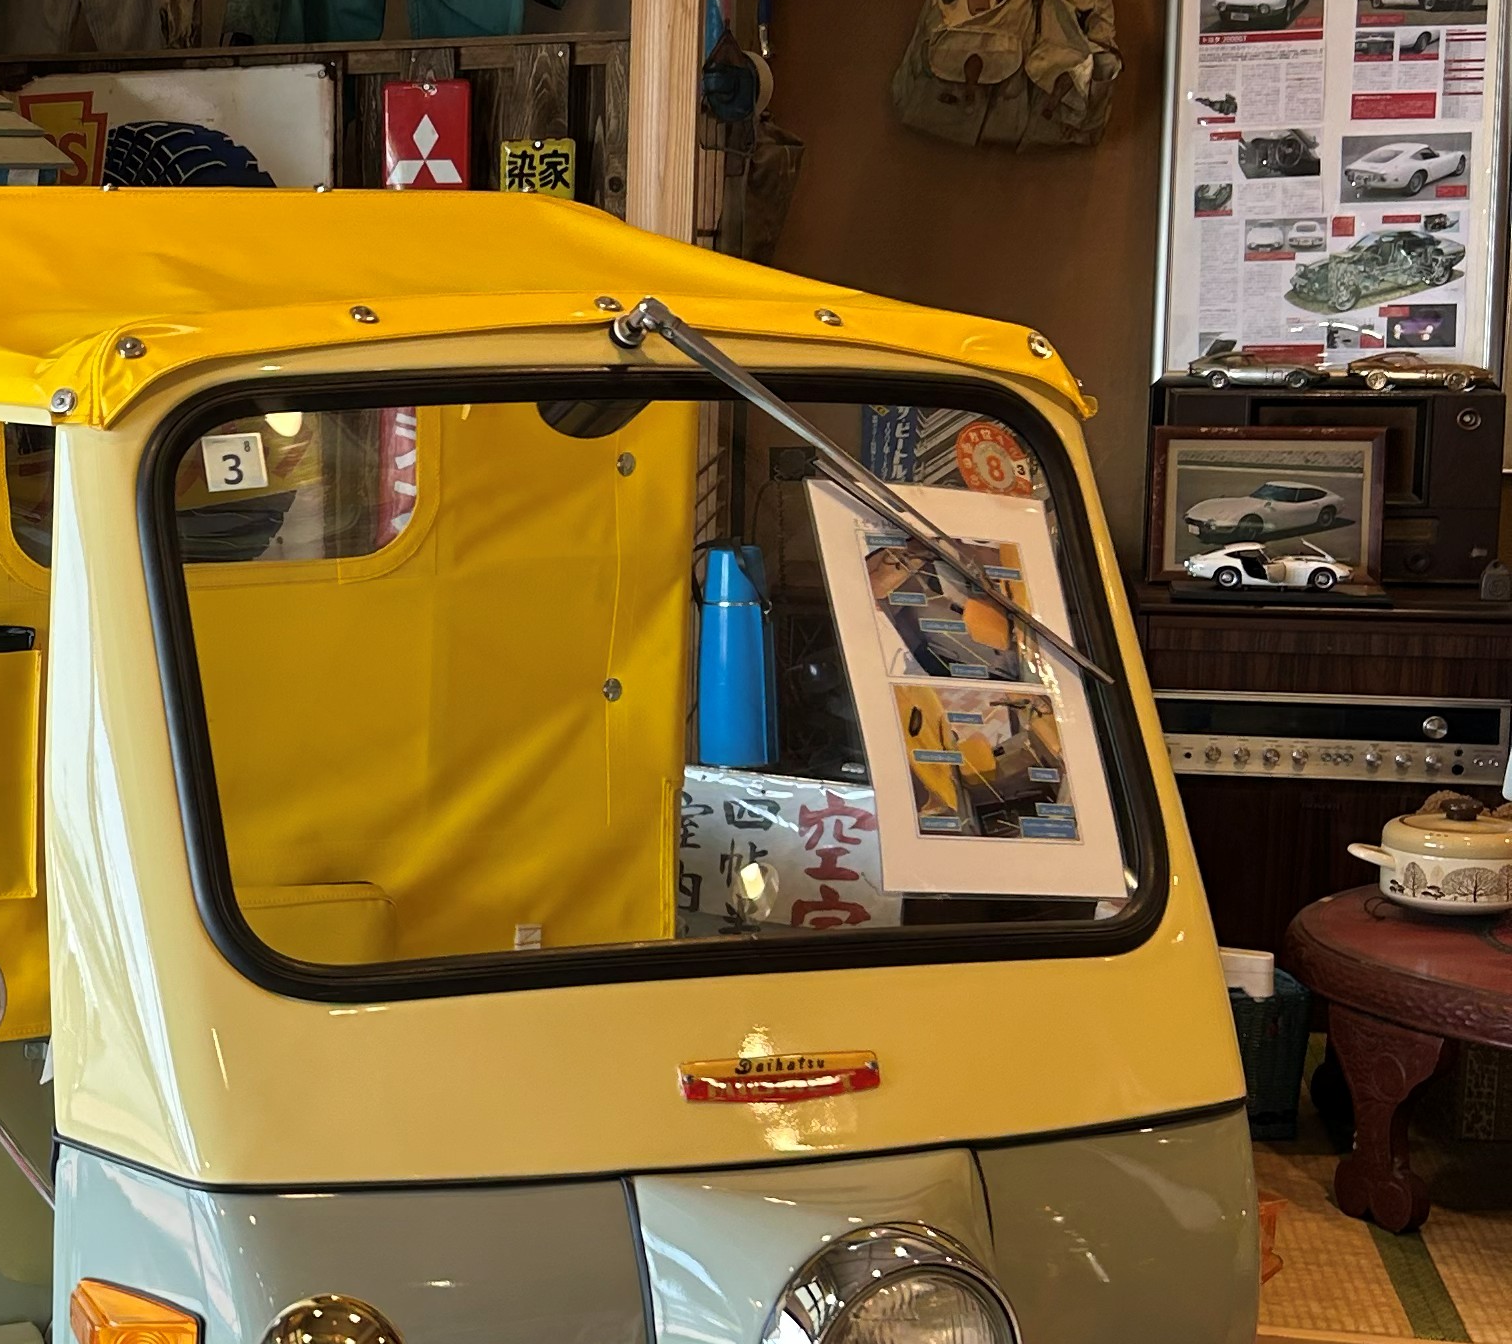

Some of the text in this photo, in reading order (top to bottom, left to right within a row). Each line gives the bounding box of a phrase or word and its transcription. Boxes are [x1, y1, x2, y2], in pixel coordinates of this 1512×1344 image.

[44, 131, 89, 186] S
[243, 440, 251, 453] 8
[221, 453, 244, 486] 3
[986, 454, 1005, 482] 8
[1016, 464, 1026, 476] 3
[735, 1057, 825, 1075] Daihatsu
